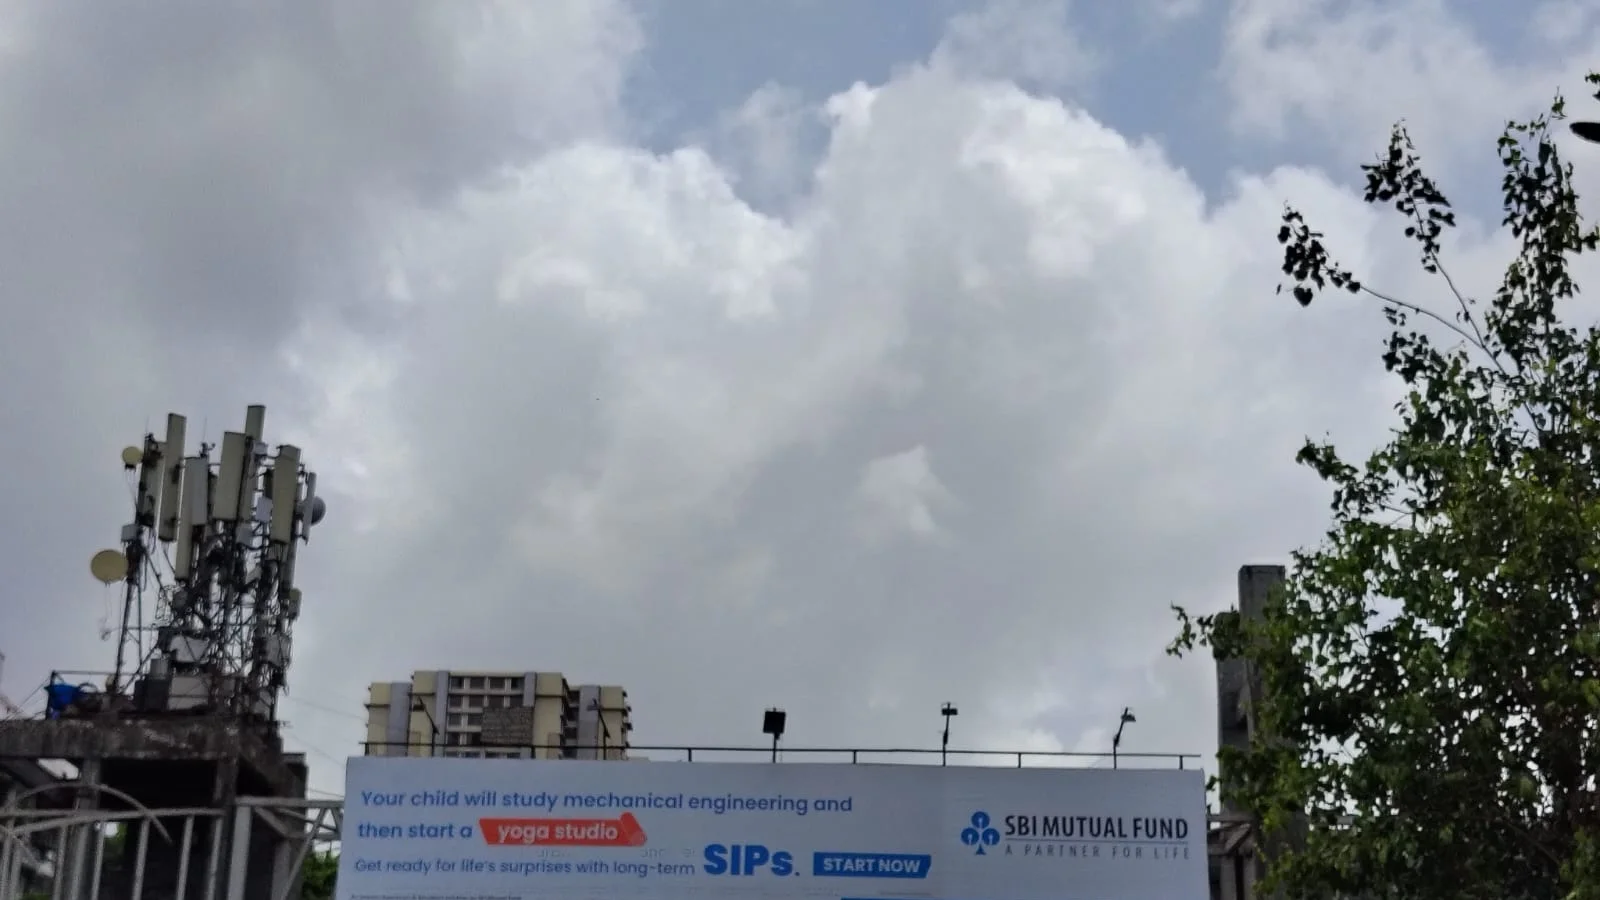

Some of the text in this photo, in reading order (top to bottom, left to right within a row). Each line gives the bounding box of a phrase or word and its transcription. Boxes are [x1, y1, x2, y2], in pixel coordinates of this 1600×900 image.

[361, 790, 853, 816] Your child will study mechanical engineering and
[358, 823, 618, 843] then start a yoga studio
[1005, 815, 1188, 839] SBI MUTUAL FUND
[355, 859, 382, 872] Get
[386, 860, 430, 875] ready
[436, 859, 456, 872] for
[461, 859, 496, 872] life's
[500, 860, 571, 876] surprises
[576, 860, 609, 873] with
[613, 861, 695, 877] long-term
[704, 843, 800, 876] SIPs.
[1005, 844, 1190, 860] A PARTNER FOR LIFE
[823, 857, 920, 873] START NOW
